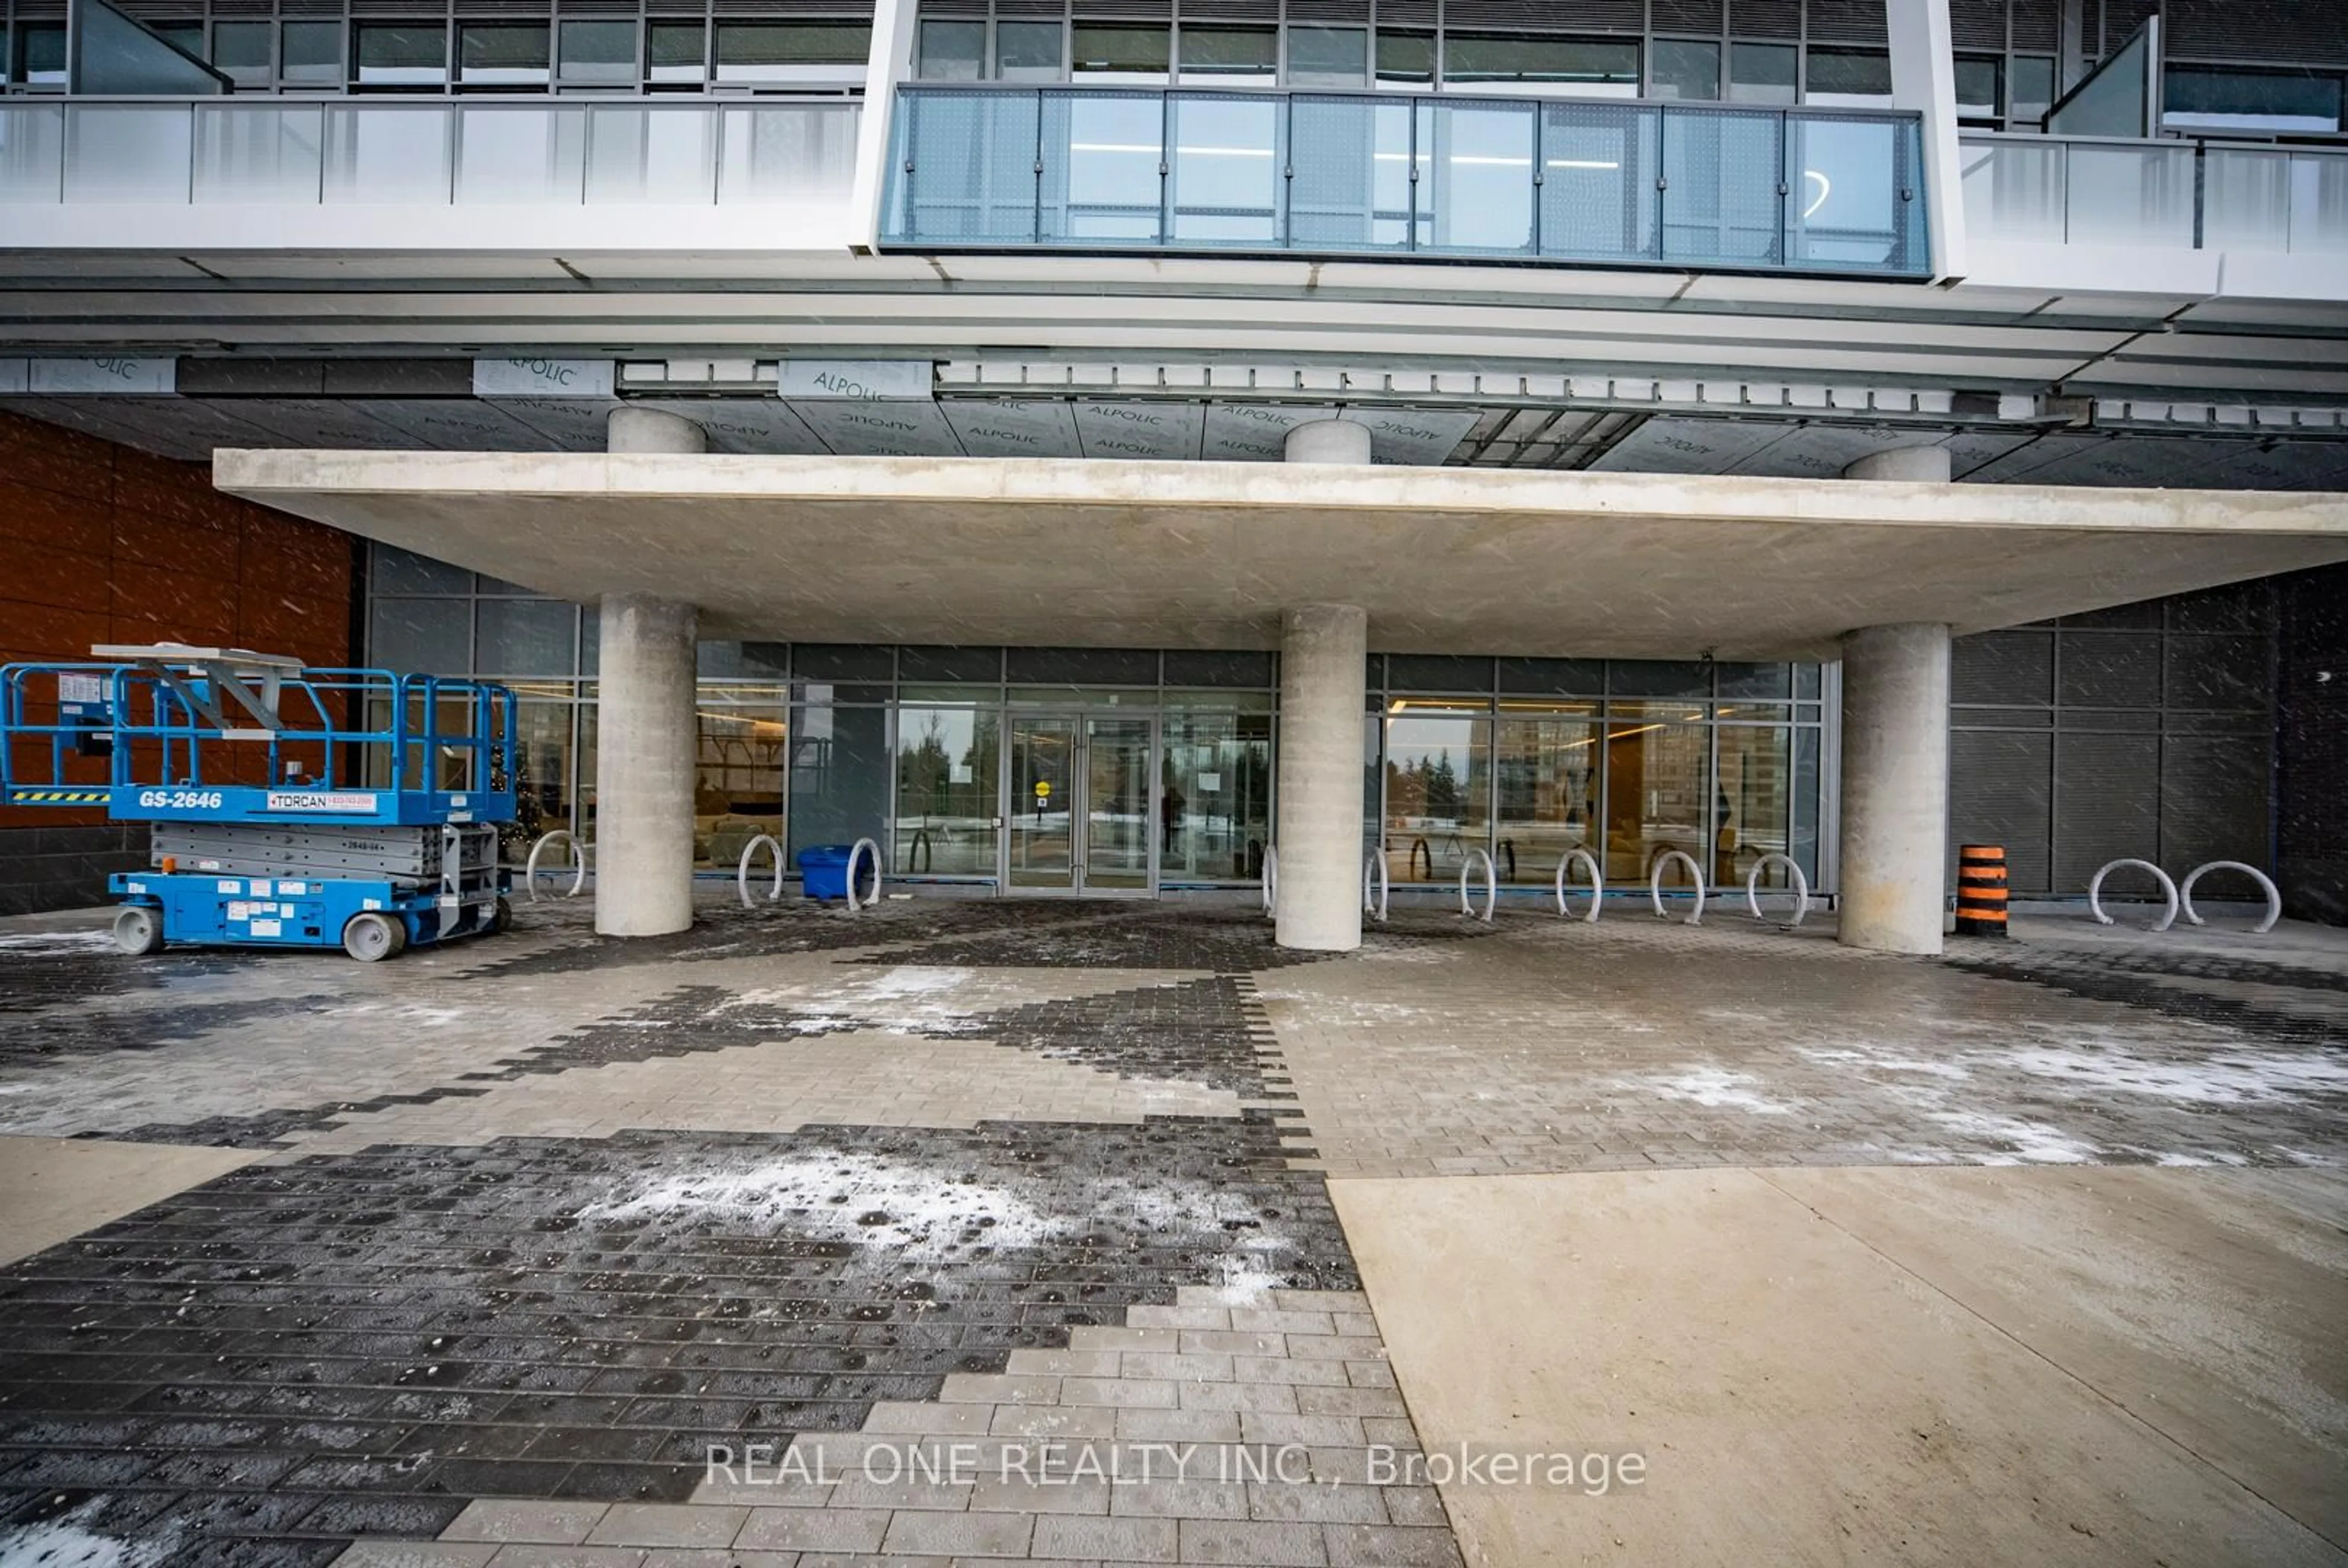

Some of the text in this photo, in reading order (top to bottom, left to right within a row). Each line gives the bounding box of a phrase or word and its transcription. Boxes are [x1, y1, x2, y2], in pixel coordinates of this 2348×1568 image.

[1088, 405, 1162, 426] ALPOLIC
[1220, 405, 1298, 427] ALPOLIC
[967, 427, 1040, 445] ALPOLIC
[139, 790, 222, 809] GS-2646
[278, 795, 327, 808] TORCAN
